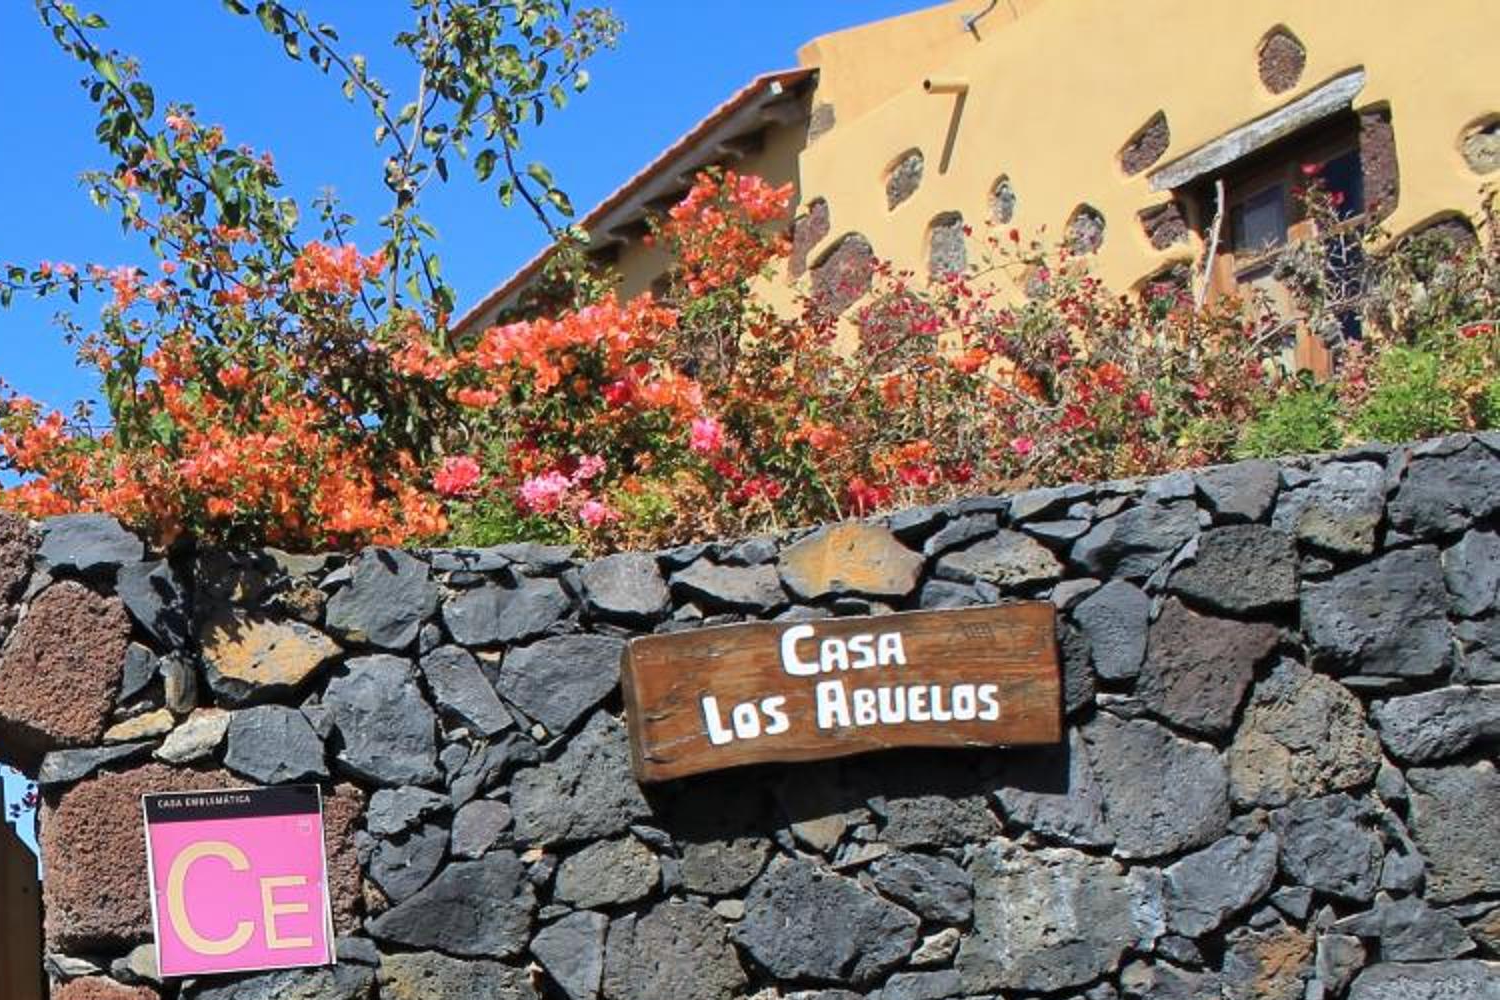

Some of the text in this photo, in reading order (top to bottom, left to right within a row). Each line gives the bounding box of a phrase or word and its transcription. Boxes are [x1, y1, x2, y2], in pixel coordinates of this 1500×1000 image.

[781, 625, 906, 676] CASA
[702, 681, 999, 745] LOS ABUELOS
[157, 798, 182, 809] CASA
